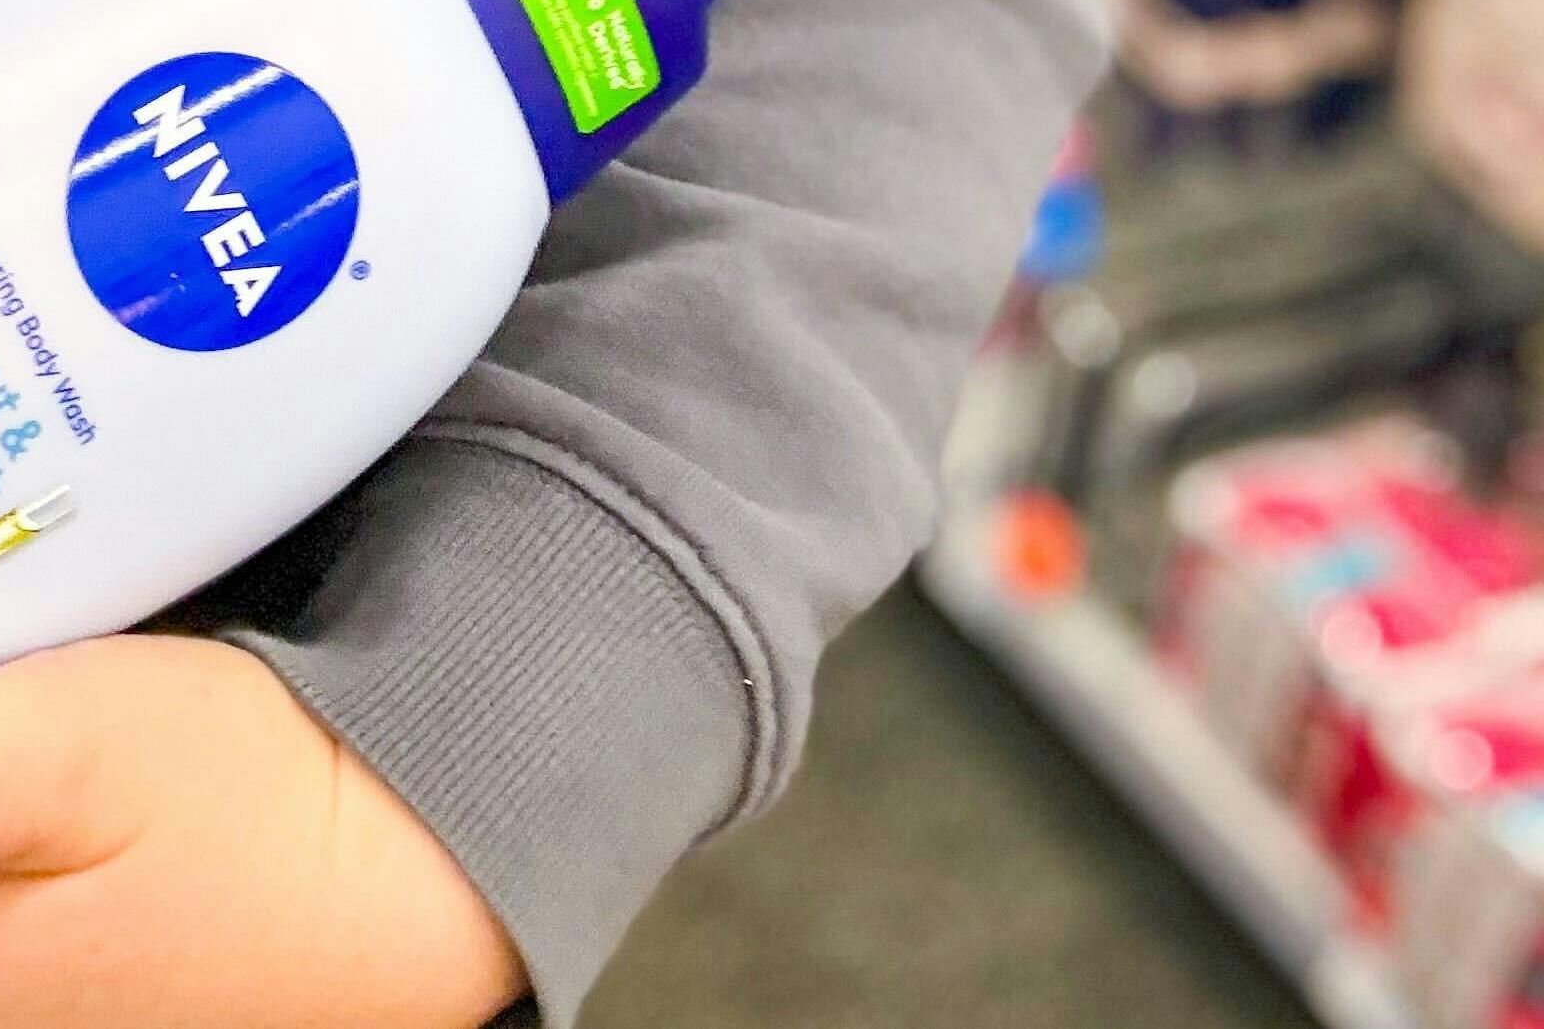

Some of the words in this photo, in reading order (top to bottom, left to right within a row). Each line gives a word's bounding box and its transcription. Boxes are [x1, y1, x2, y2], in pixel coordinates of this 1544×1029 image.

[132, 84, 282, 318] NIVEA
[0, 418, 43, 460] &
[17, 316, 59, 379] Body
[52, 376, 96, 445] Wash
